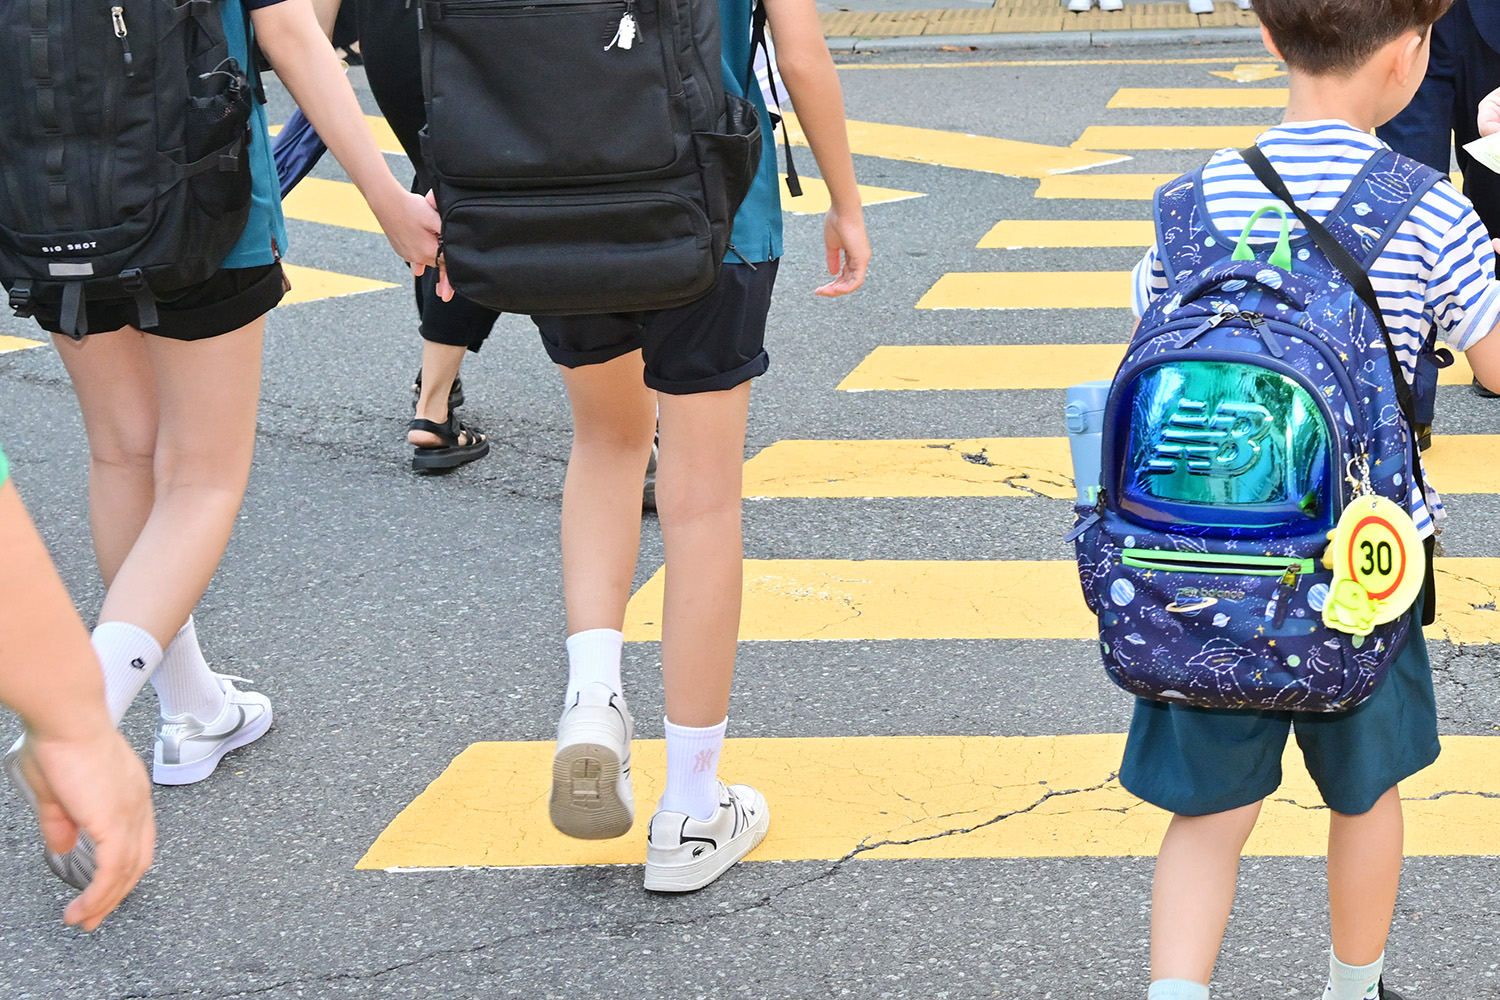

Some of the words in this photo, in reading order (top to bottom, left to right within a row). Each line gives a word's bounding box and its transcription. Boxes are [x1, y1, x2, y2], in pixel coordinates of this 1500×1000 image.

[66, 241, 97, 251] SHOT
[1359, 540, 1393, 577] 30
[160, 723, 188, 737] NIKE
